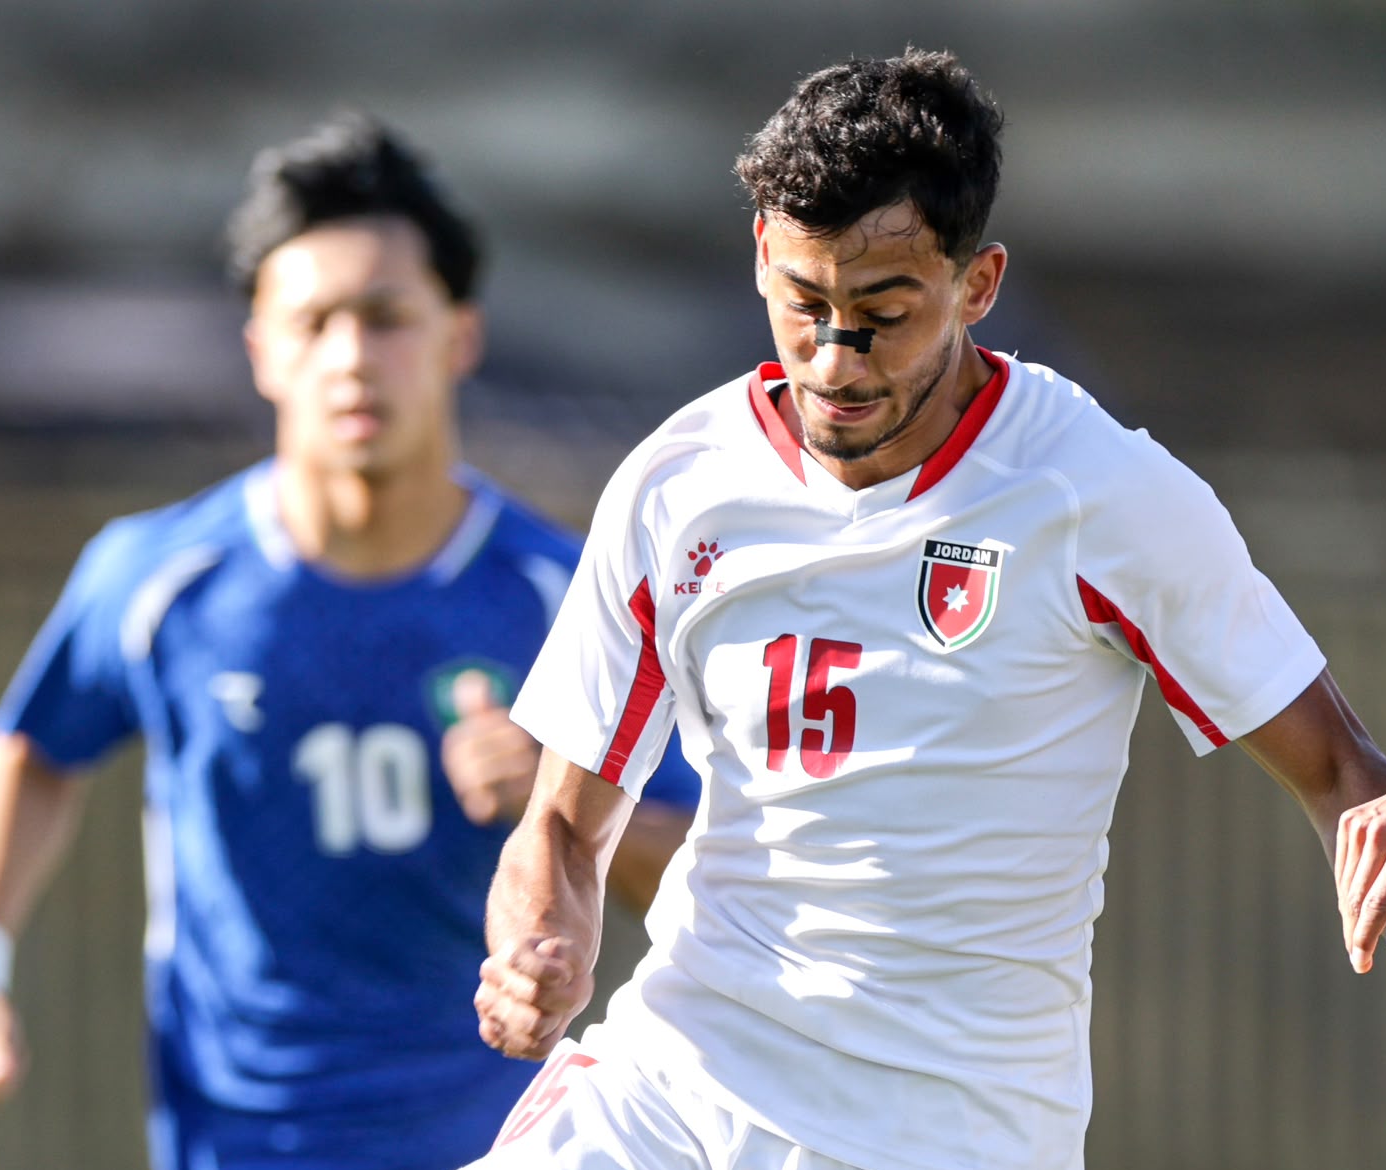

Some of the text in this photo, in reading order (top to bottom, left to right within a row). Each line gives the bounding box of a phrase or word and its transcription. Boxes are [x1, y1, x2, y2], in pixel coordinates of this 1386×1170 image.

[933, 543, 992, 565] JORDAN
[762, 632, 863, 779] 15
[293, 720, 433, 857] 10
